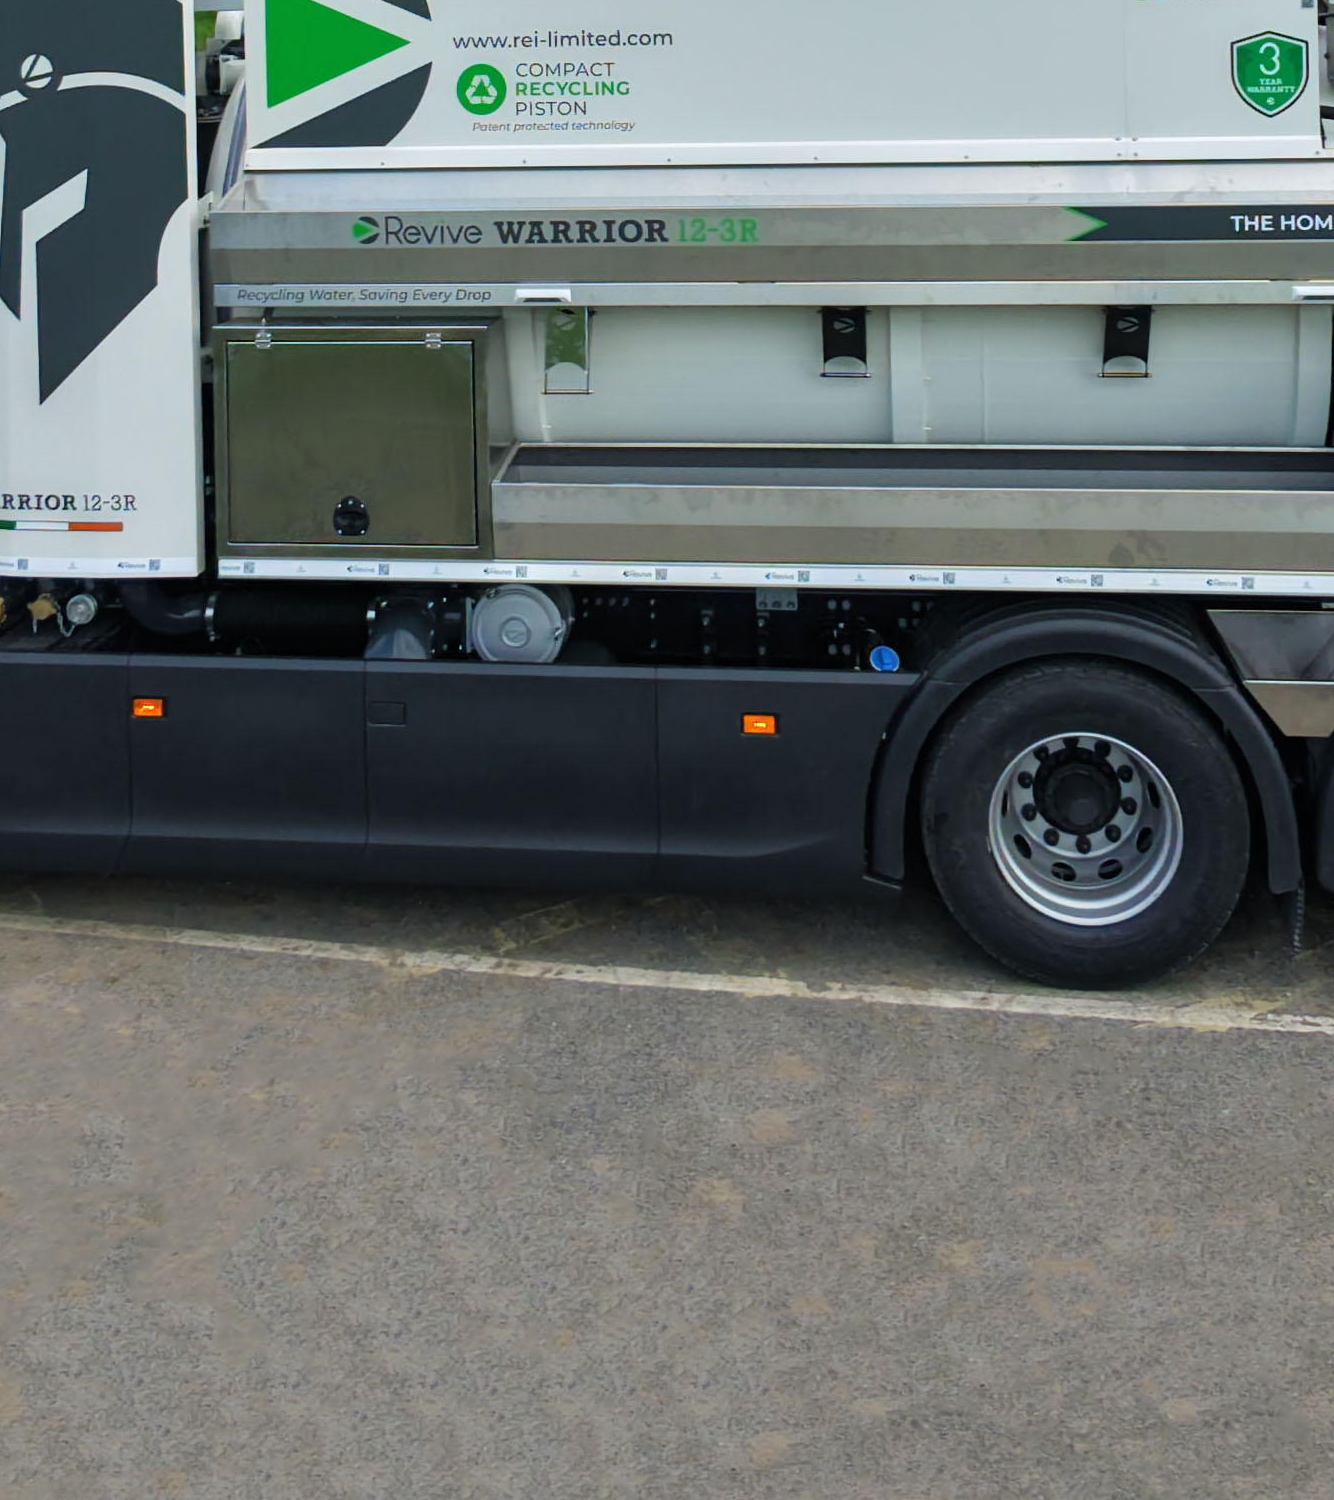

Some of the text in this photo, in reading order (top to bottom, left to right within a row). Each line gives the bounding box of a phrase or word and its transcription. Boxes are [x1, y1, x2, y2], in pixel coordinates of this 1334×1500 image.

[452, 30, 673, 49] www.rei-limited.com
[1259, 41, 1280, 76] 3
[515, 62, 616, 77] COMPACT
[515, 81, 631, 96] RECYCLING
[515, 101, 587, 116] PISTON
[472, 120, 636, 133] Patent protected technology
[384, 216, 760, 245] Revive WARRIOR 12-3R
[1230, 214, 1274, 232] THE
[237, 289, 305, 303] Recycling
[358, 288, 408, 303] Saving
[412, 288, 452, 304] Every
[455, 288, 492, 303] Drop
[83, 494, 137, 511] 12-3R
